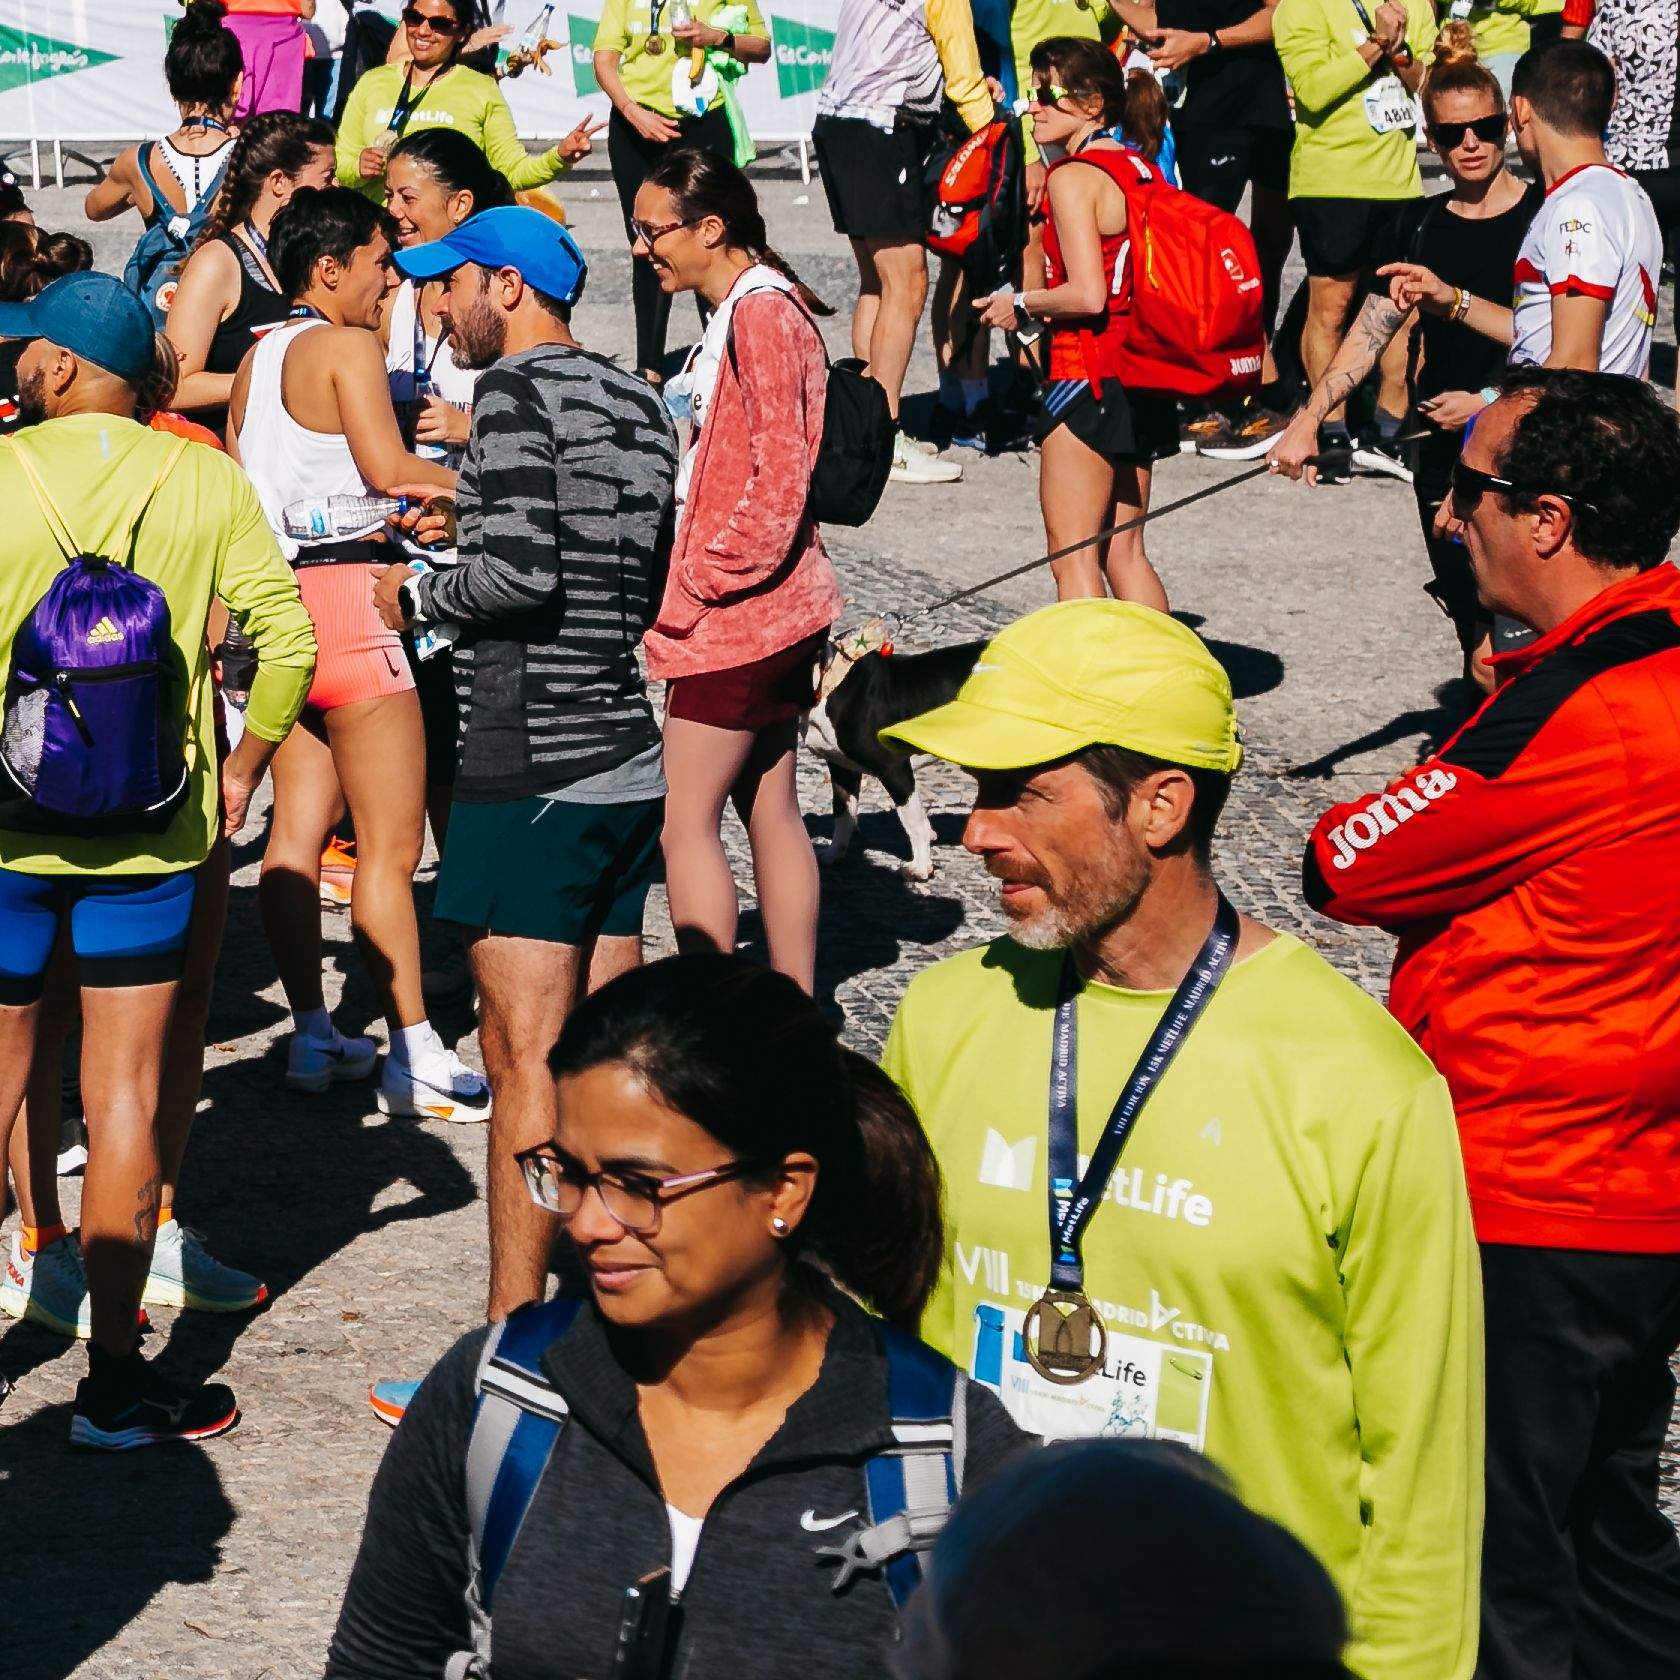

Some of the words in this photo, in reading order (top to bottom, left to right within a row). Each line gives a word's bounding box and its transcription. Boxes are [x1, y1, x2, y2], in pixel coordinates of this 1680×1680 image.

[410, 110, 454, 124] etLife
[87, 632, 125, 644] adidas
[1060, 1022, 1070, 1068] MADRID
[1113, 1115, 1128, 1136] VIII
[1148, 1051, 1165, 1075] 15K
[1158, 1012, 1189, 1055] METLIFE
[1185, 968, 1213, 1012] MADRID
[1209, 933, 1231, 977] ACTIVA
[1056, 1070, 1067, 1108] ACTIVA
[1077, 1153, 1215, 1227] tLife
[1061, 1197, 1089, 1244] MetLife
[955, 1241, 1009, 1296] VIII
[1015, 1280, 1047, 1301] 15K
[1091, 1299, 1149, 1328] ADRID
[1095, 1359, 1147, 1387] Life
